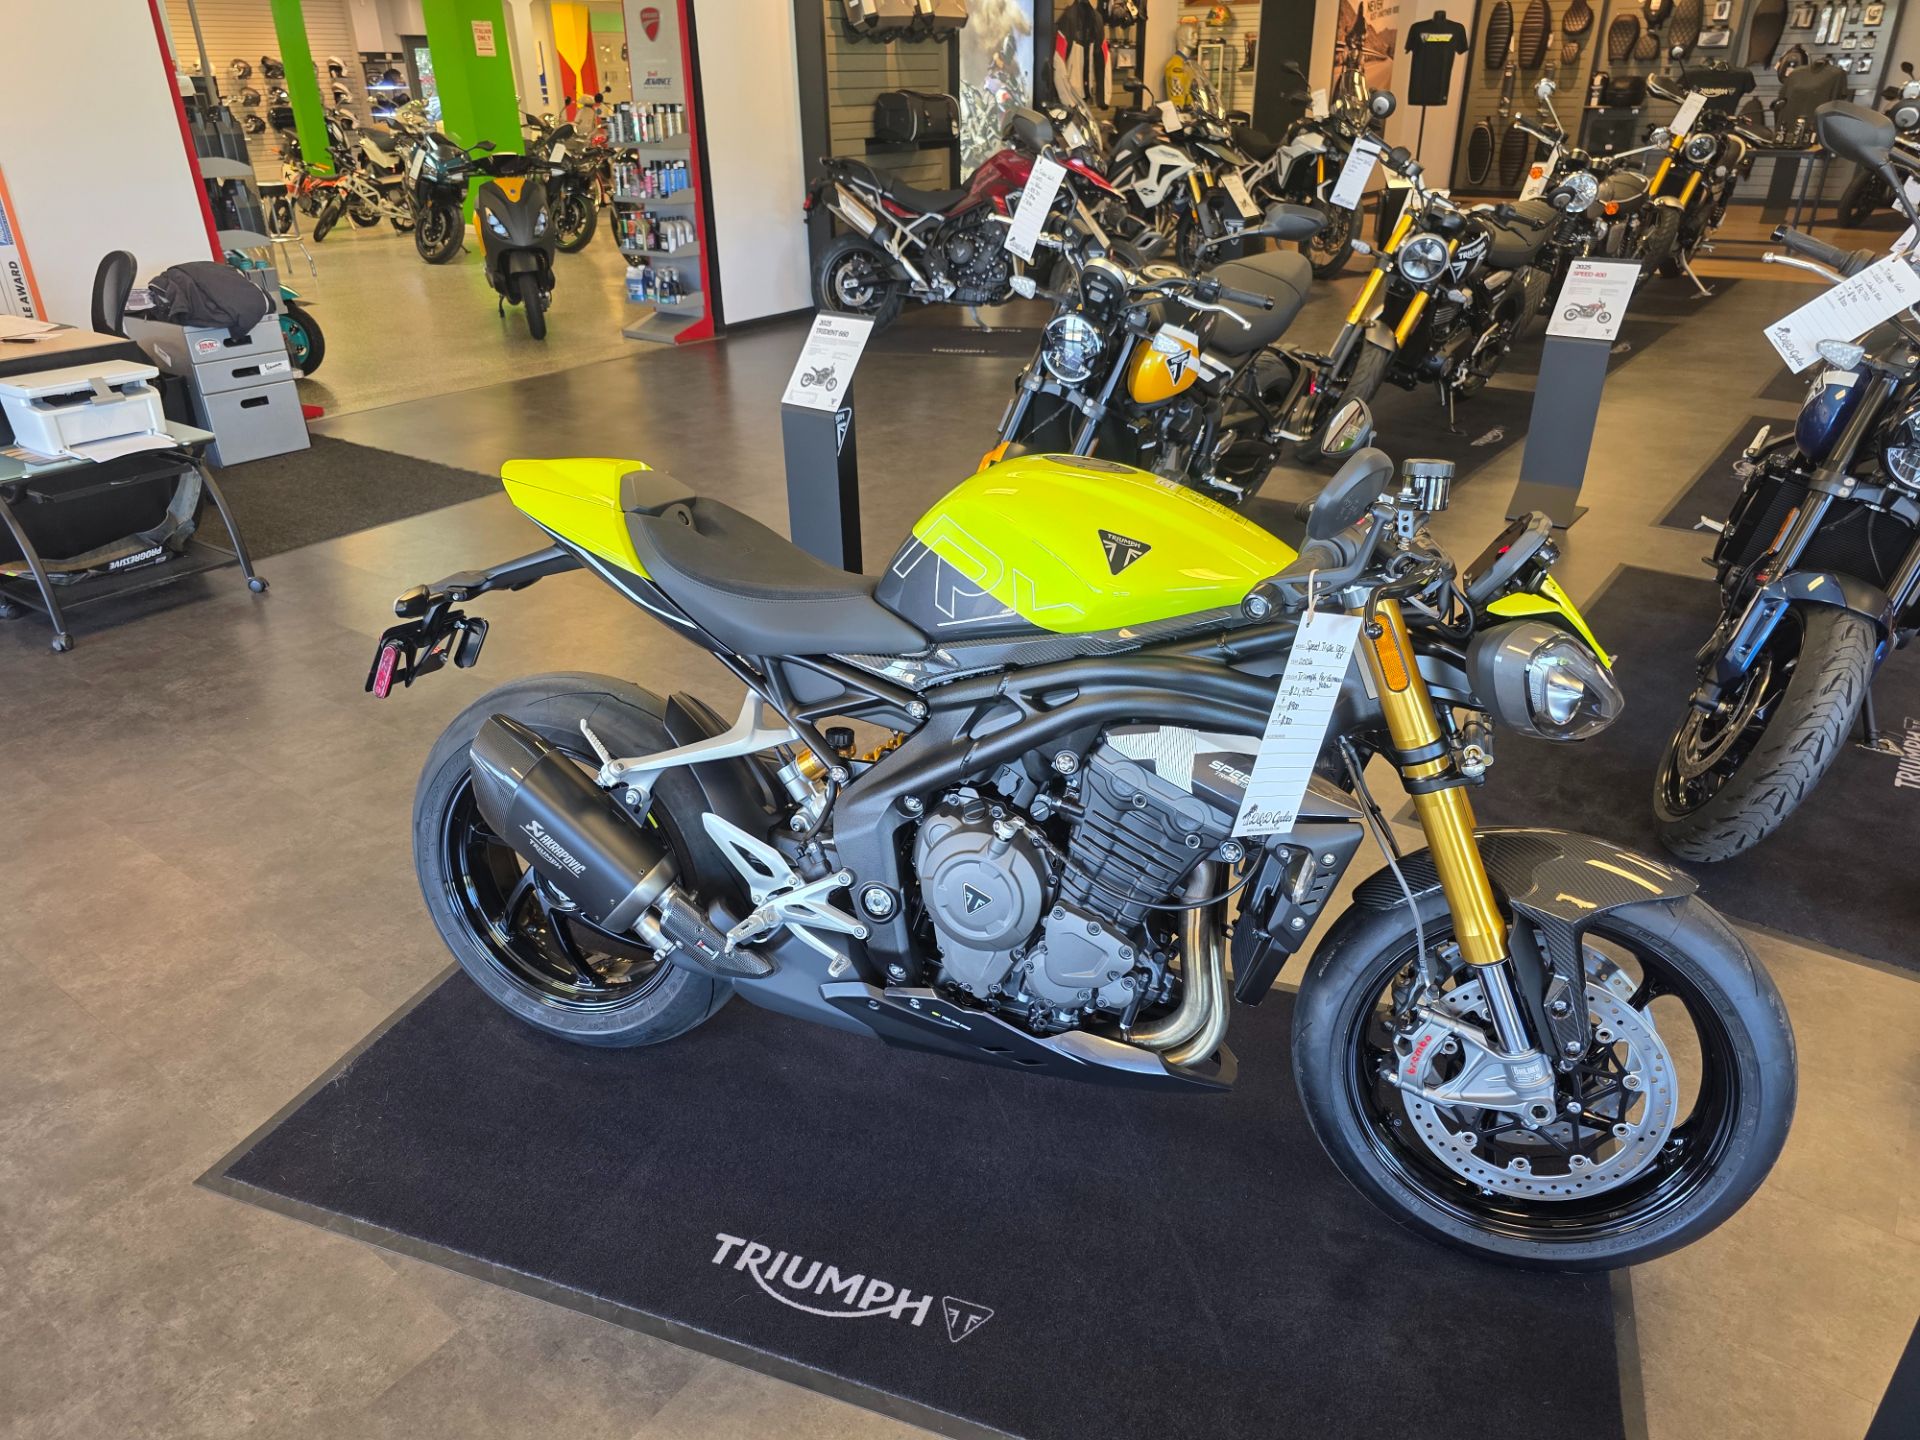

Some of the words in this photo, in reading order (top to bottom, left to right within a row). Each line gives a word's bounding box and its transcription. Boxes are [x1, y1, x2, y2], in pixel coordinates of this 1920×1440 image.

[9, 261, 30, 304] AWARD
[815, 327, 840, 337] TRIDENT
[818, 319, 833, 327] 2025
[1107, 533, 1141, 549] TRIUMPH
[109, 546, 163, 570] PROGRESSIVE
[1298, 671, 1317, 683] Triumph
[1288, 685, 1314, 697] $21,495
[1208, 760, 1251, 783] SPEE
[1271, 811, 1292, 827] Cycles
[529, 838, 563, 870] TRIUMPH
[1407, 1034, 1432, 1076] brembo
[711, 1232, 934, 1327] TRIUMPH
